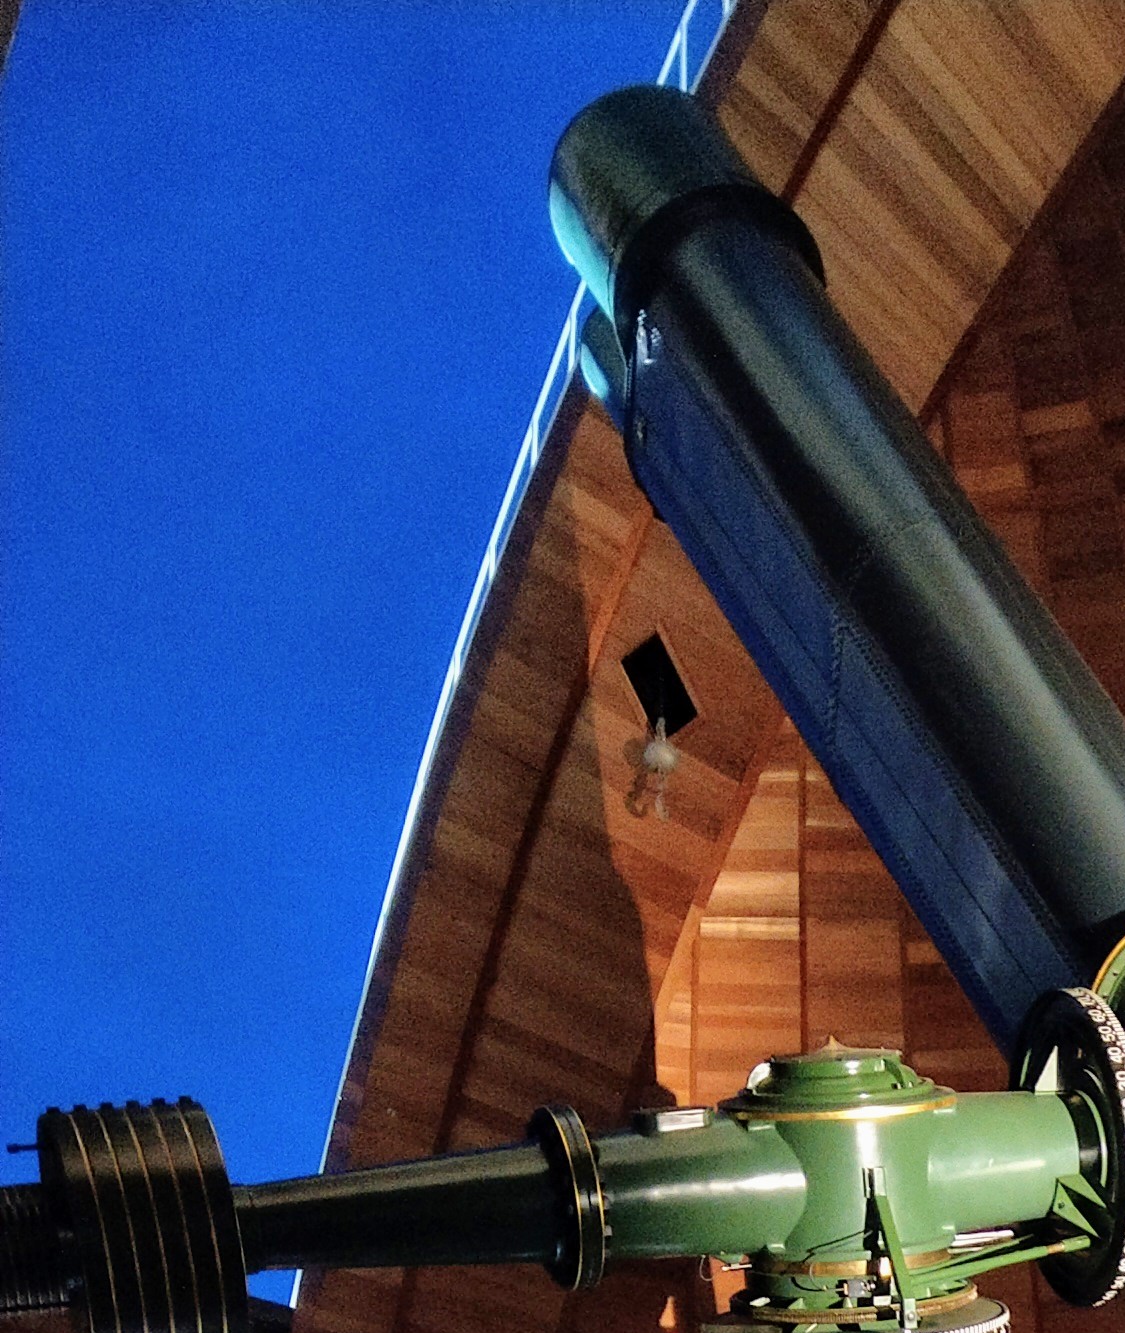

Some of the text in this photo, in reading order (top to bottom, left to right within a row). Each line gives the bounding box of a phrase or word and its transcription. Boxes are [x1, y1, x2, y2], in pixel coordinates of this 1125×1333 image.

[1087, 1009, 1106, 1023] 60
[1098, 1026, 1115, 1042] 50
[1106, 1046, 1123, 1063] 40
